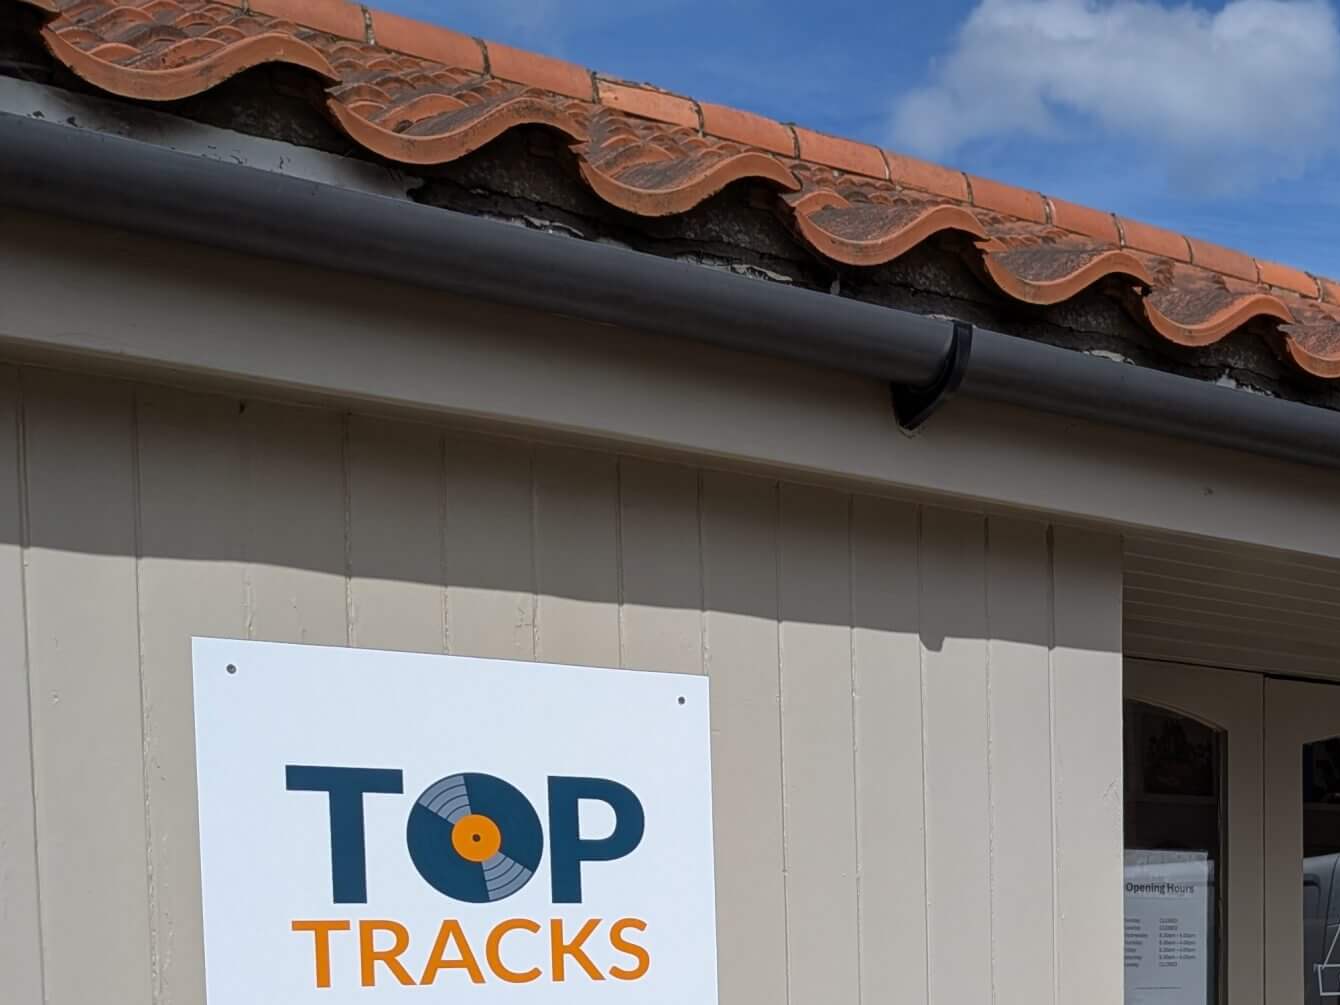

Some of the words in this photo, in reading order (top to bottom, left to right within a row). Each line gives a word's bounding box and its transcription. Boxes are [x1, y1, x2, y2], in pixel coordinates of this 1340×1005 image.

[285, 765, 645, 904] TOP
[1126, 882, 1165, 895] Opening
[1167, 883, 1194, 893] Hours
[291, 918, 650, 988] TRACKS
